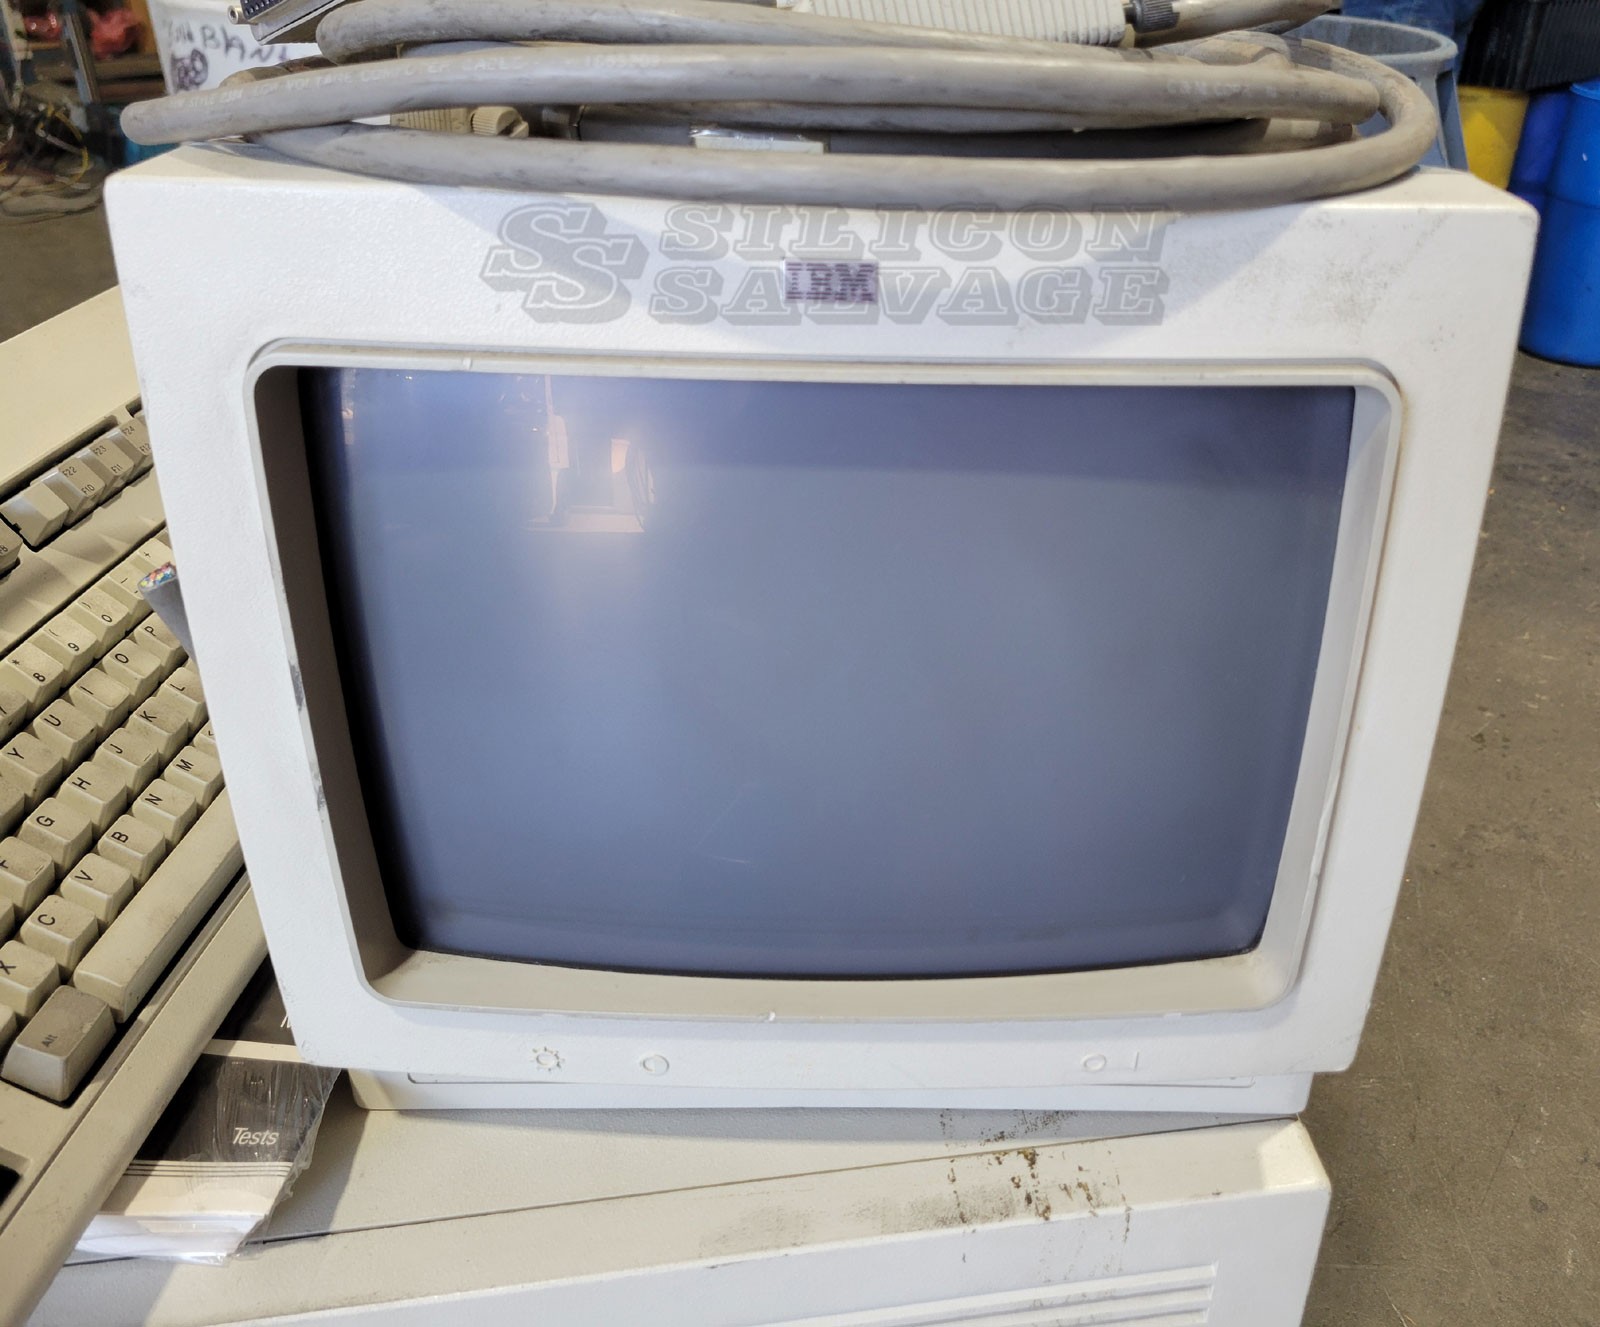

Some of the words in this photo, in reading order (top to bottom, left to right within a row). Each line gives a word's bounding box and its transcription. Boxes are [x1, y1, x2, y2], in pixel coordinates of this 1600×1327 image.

[786, 262, 875, 302] IBM
[122, 425, 136, 436] F24
[93, 445, 107, 456] F23
[62, 466, 77, 477] F22
[111, 463, 123, 474] F11
[81, 484, 96, 495] F10
[144, 626, 157, 637] P
[68, 642, 80, 652] 9
[33, 672, 46, 682] 8
[170, 683, 185, 692] L
[43, 713, 61, 727] U
[140, 710, 157, 722] K
[7, 747, 25, 759] Y
[110, 743, 124, 754] J
[176, 759, 194, 772] M
[72, 776, 91, 791] H
[145, 793, 163, 806] N
[36, 814, 55, 828] G
[111, 831, 129, 844] B
[74, 869, 93, 883] V
[38, 913, 55, 927] C
[41, 1033, 58, 1049] Alt
[232, 1127, 279, 1146] Tests
